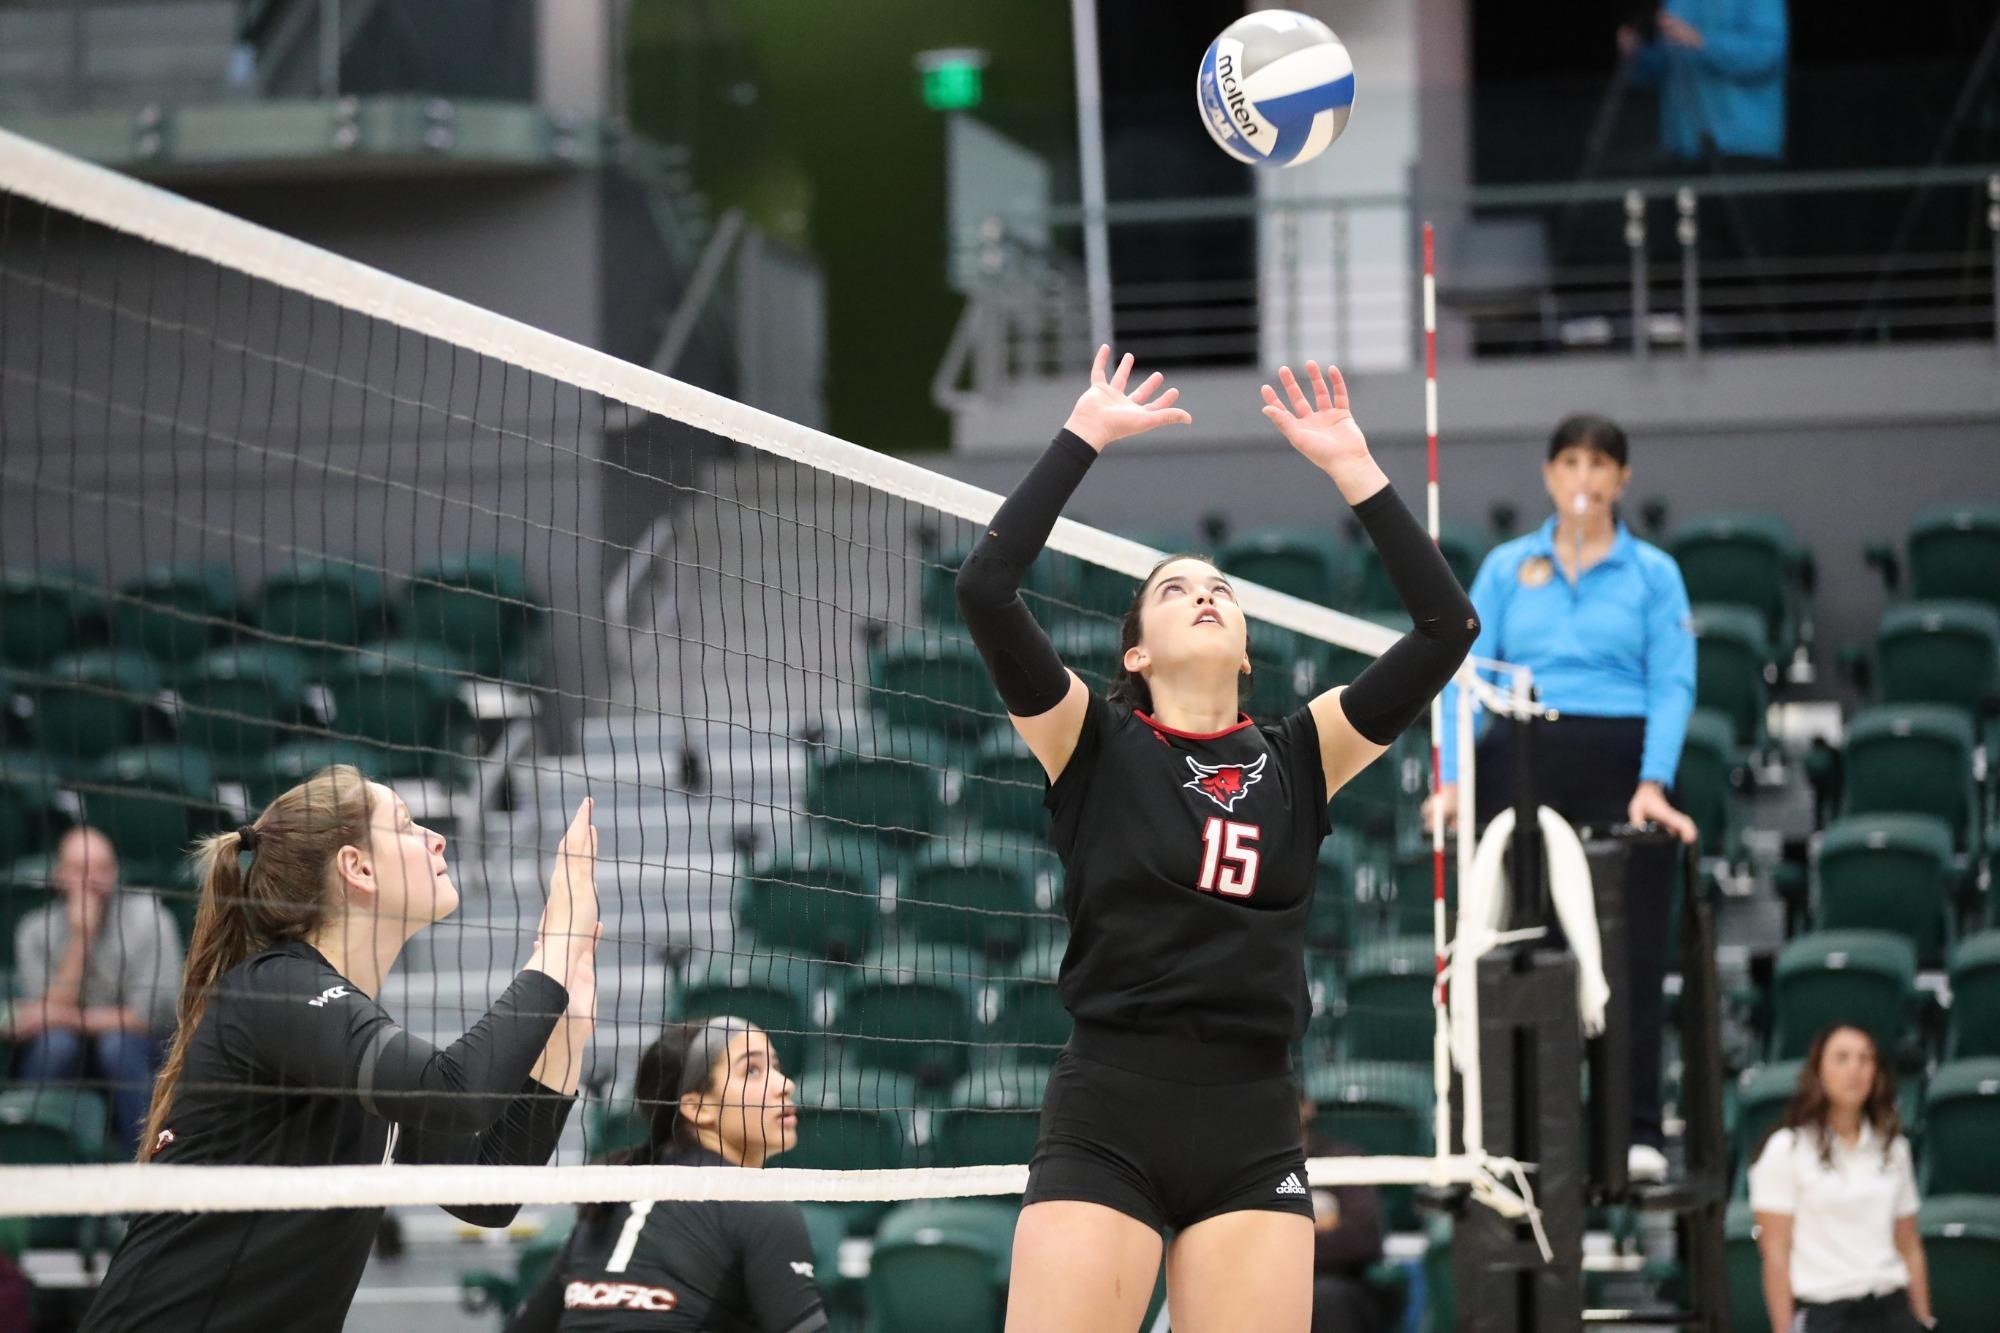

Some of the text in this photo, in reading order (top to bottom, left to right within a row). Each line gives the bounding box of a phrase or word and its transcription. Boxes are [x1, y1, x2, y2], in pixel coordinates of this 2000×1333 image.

[1218, 54, 1259, 137] molten
[1197, 816, 1261, 898] 15
[1275, 1185, 1307, 1195] adidas
